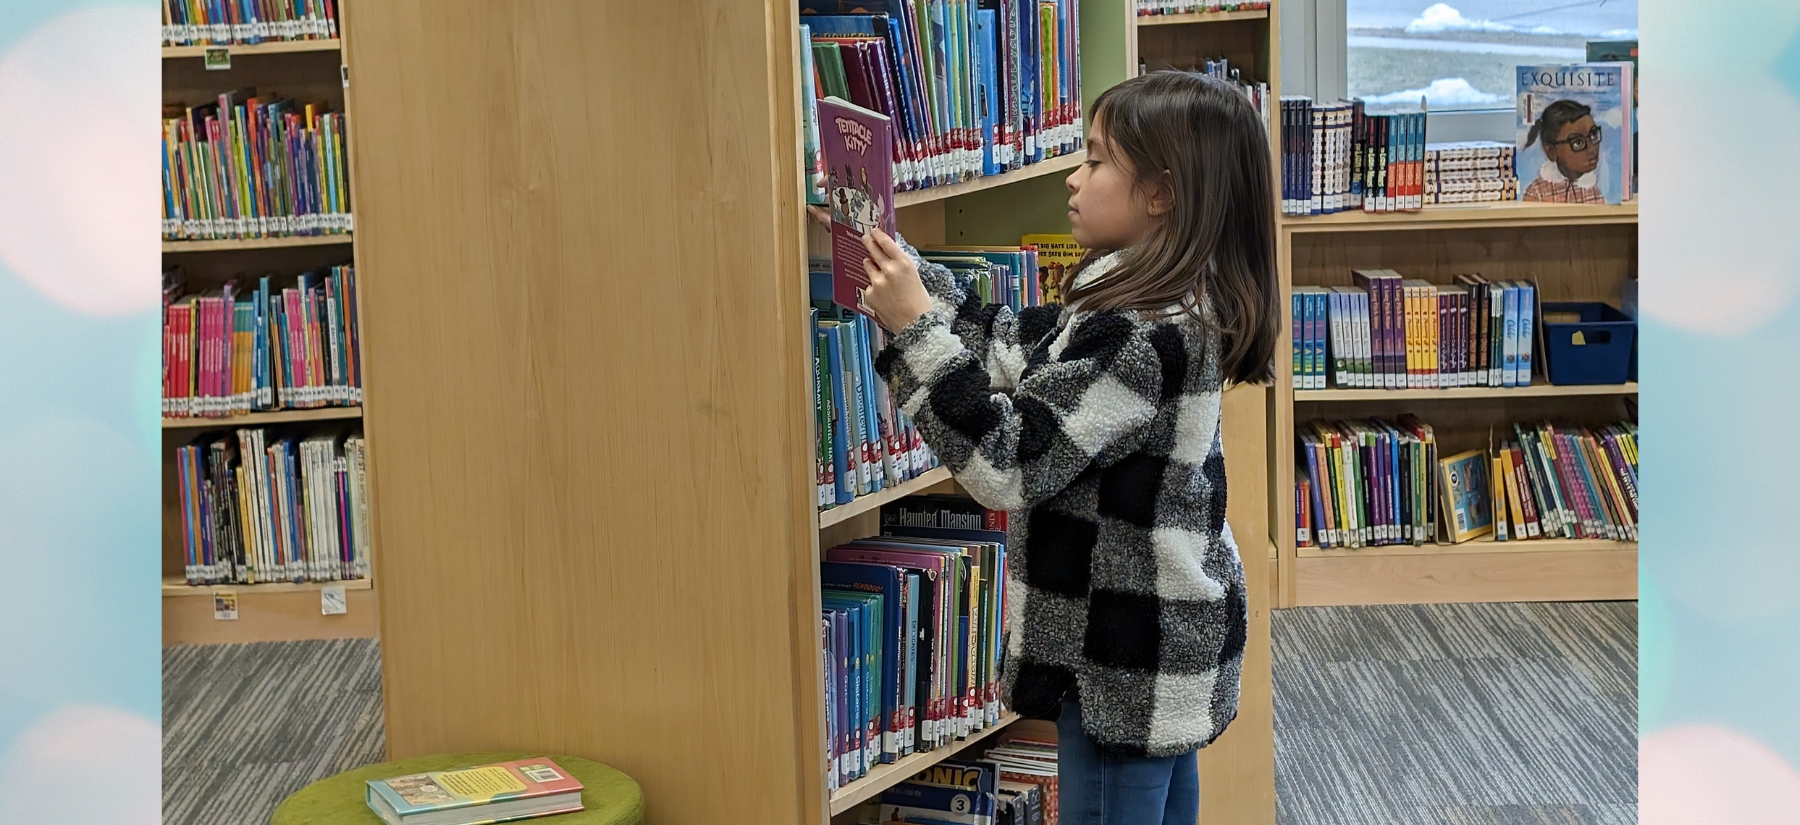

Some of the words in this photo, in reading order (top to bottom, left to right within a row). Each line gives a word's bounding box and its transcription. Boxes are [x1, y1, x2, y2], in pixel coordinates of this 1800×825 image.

[1521, 72, 1615, 88] EXQUISITE
[835, 117, 873, 146] TENTACLE
[856, 384, 867, 442] Doodlevill
[899, 507, 939, 529] Haunted
[941, 510, 982, 530] Mansion
[914, 767, 979, 791] ONIC
[956, 799, 965, 811] 3
